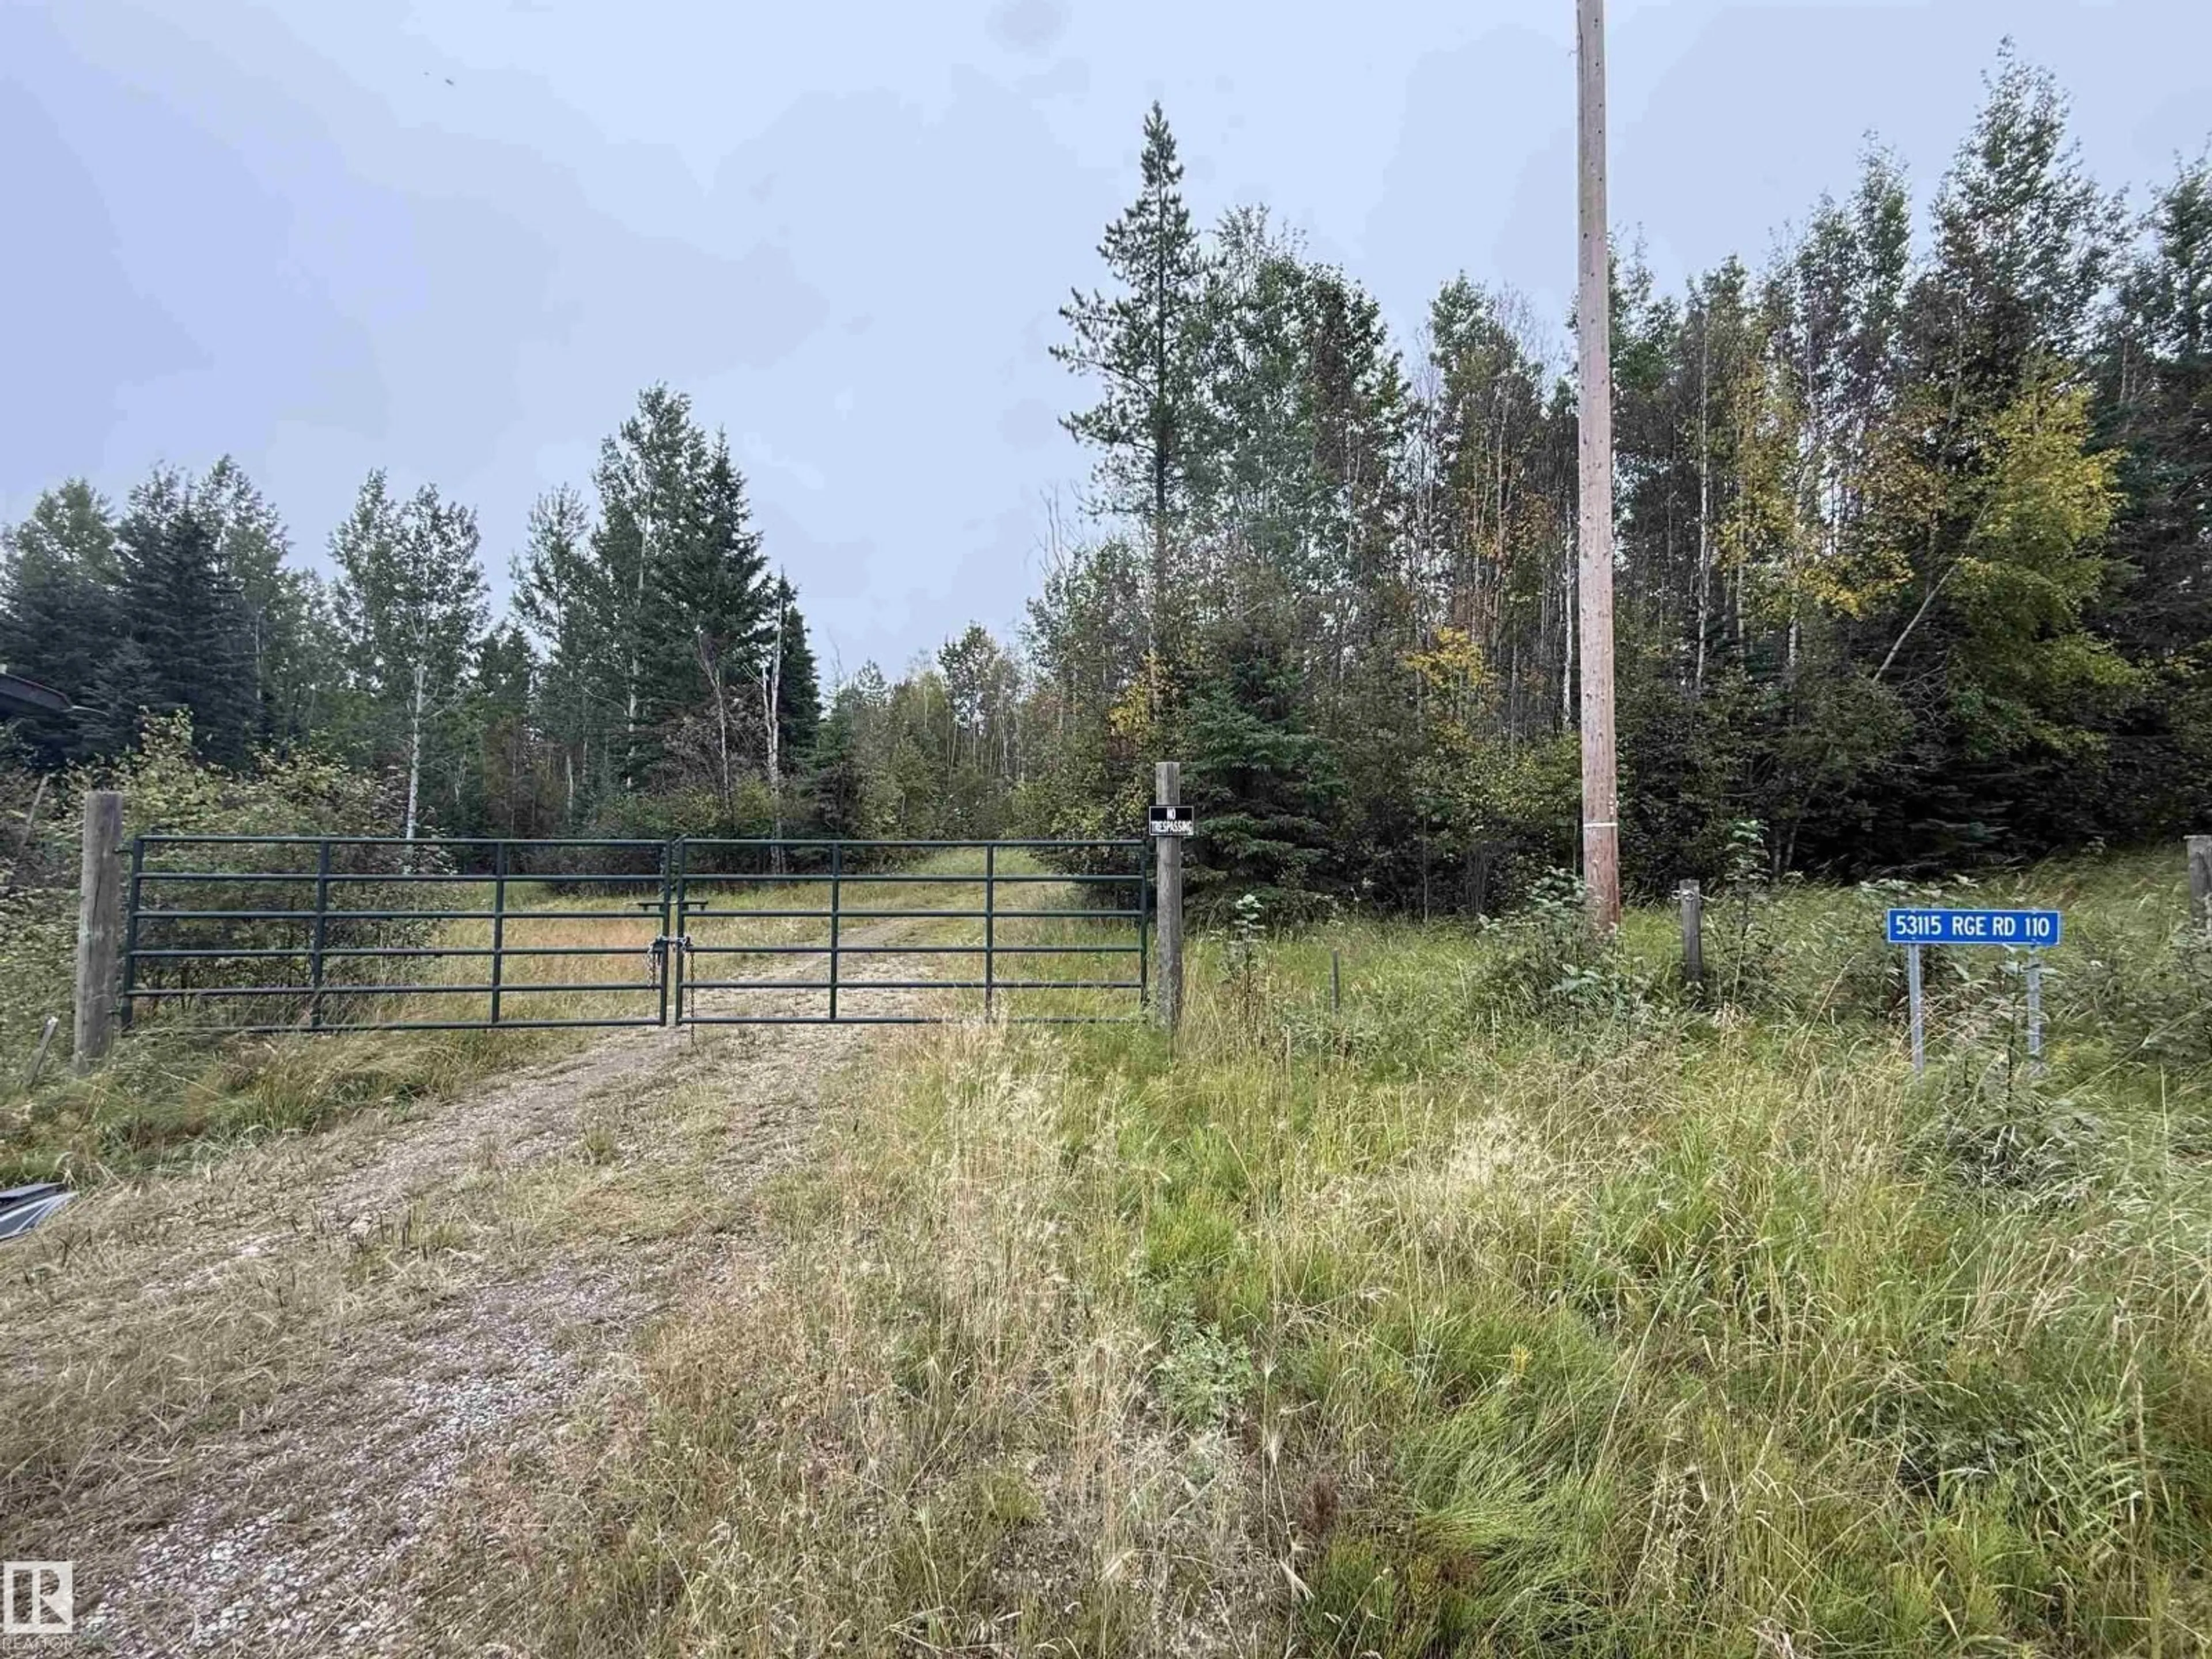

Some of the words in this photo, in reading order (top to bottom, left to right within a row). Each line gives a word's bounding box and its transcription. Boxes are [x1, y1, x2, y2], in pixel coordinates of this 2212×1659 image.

[1166, 808, 1176, 820] NO
[1896, 915, 1942, 935] 53115
[1952, 916, 1986, 935] RGE
[1992, 916, 2015, 936] RD
[2025, 918, 2050, 936] 110
